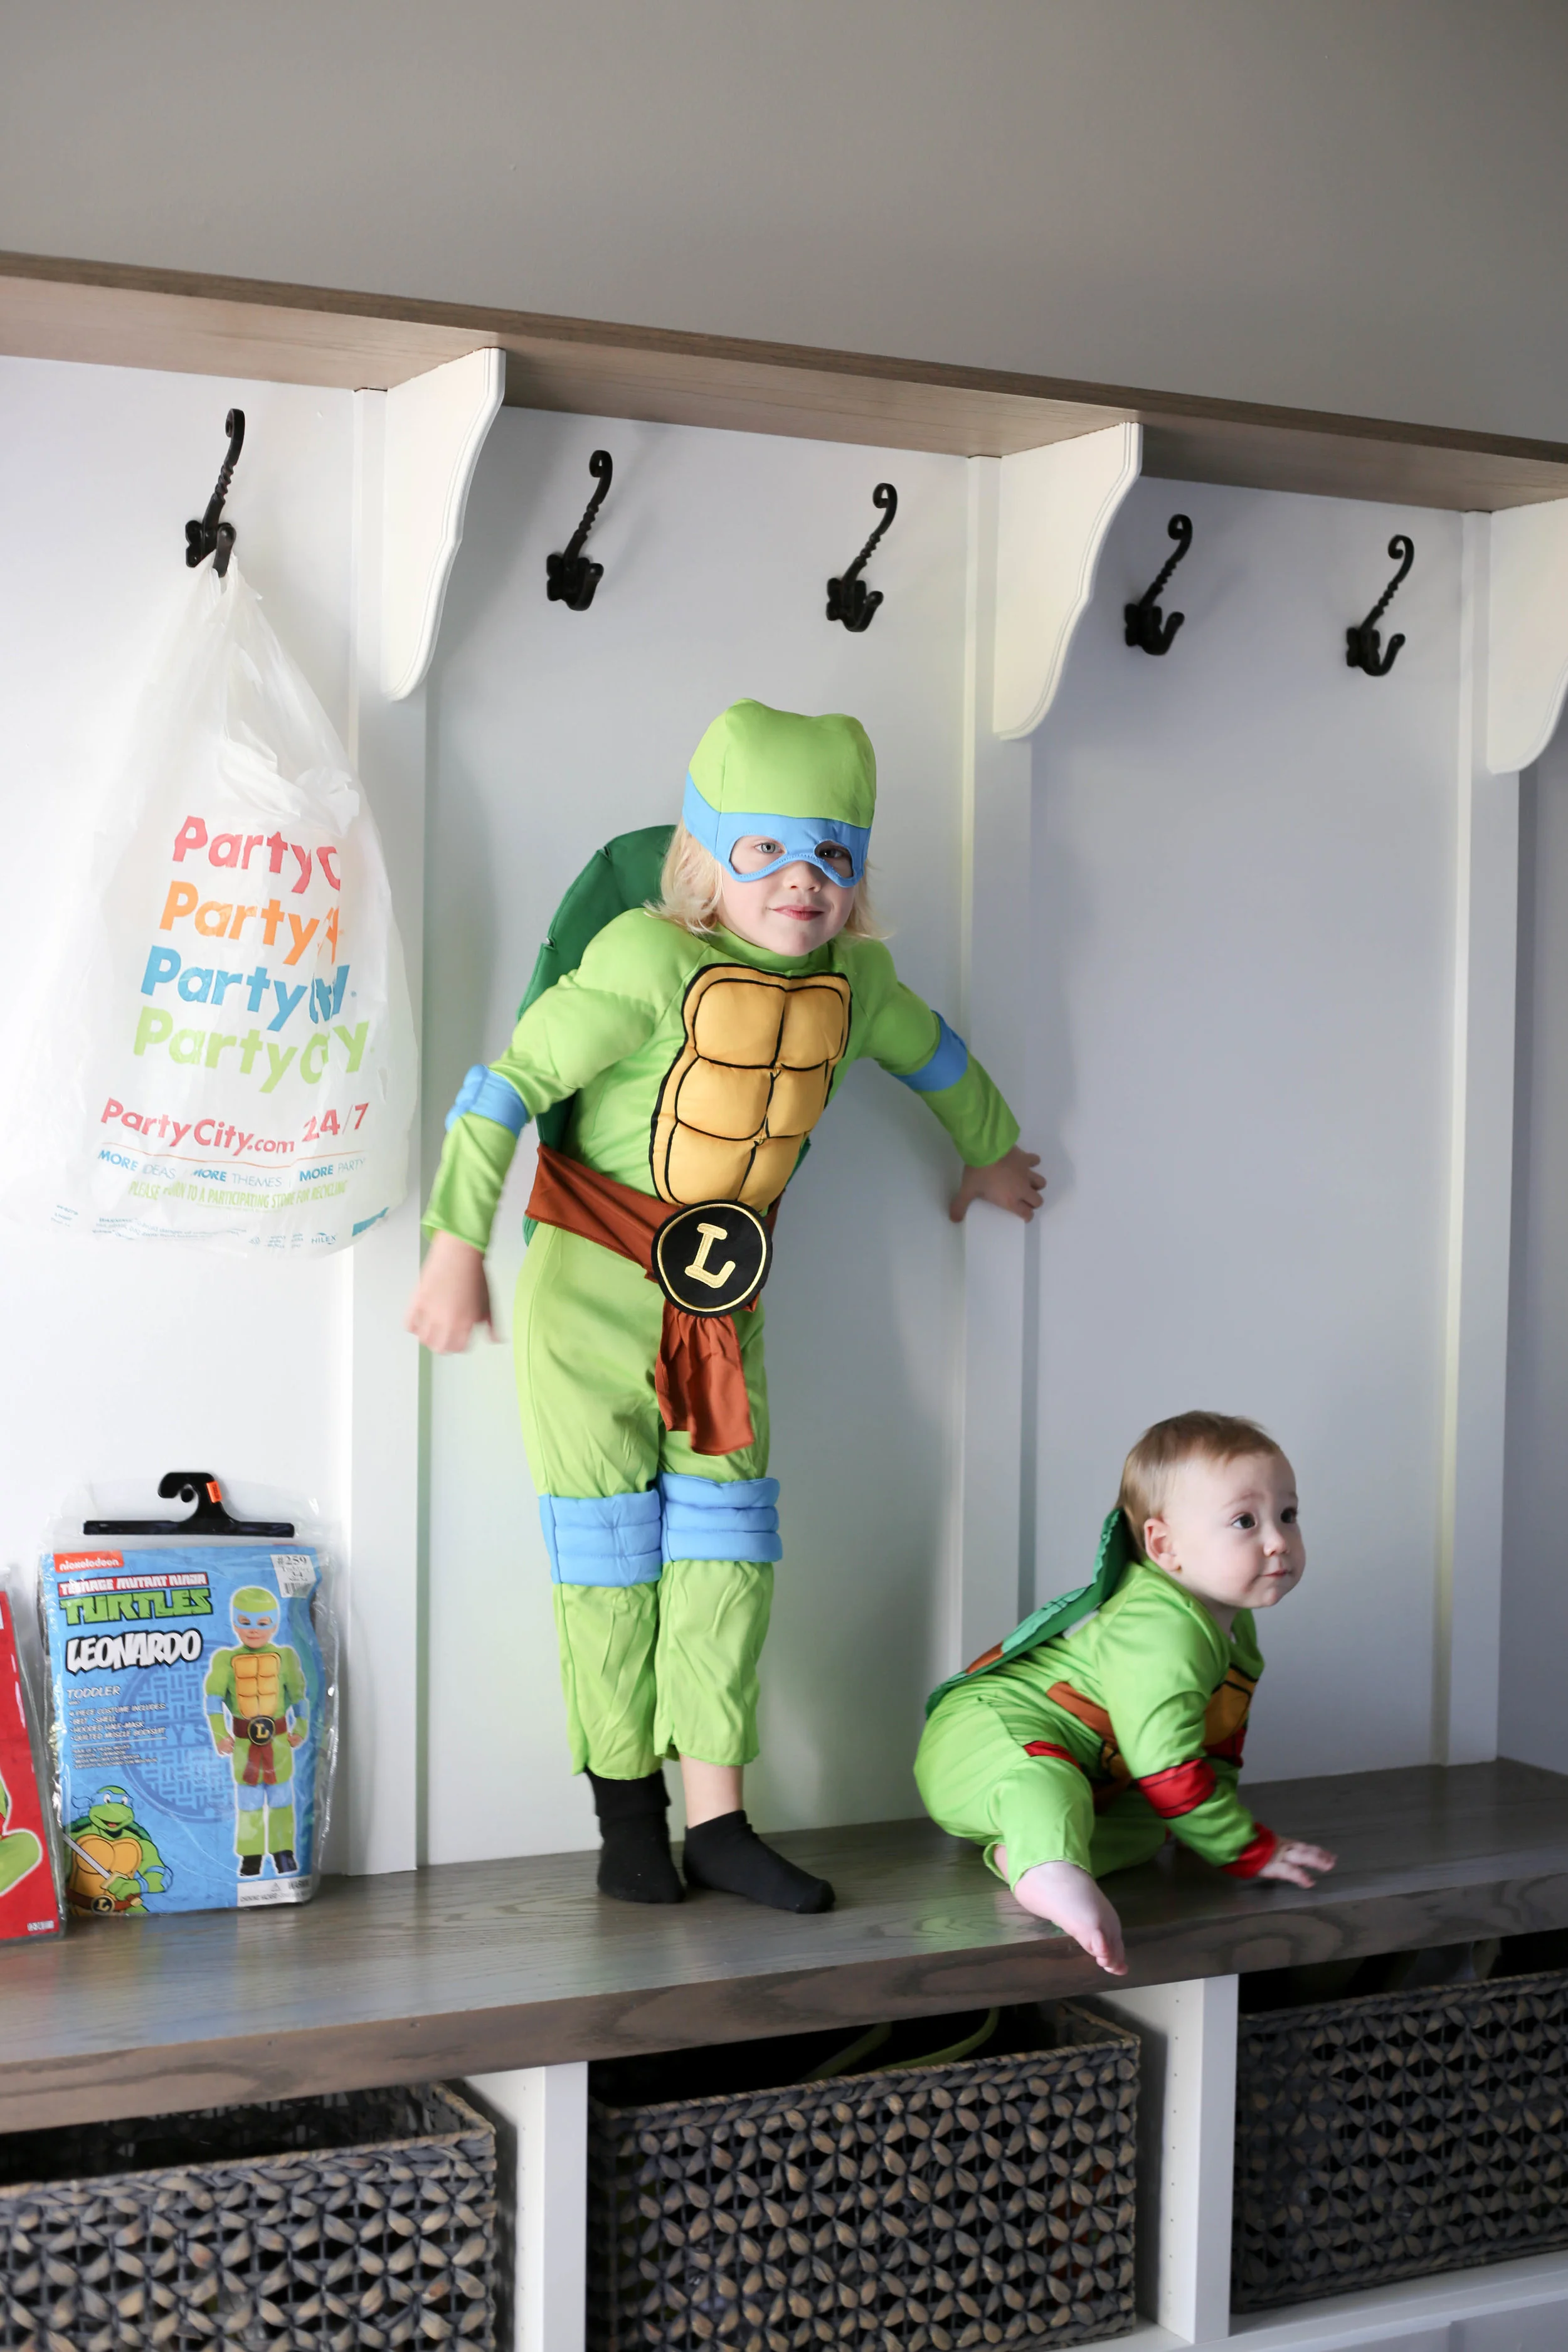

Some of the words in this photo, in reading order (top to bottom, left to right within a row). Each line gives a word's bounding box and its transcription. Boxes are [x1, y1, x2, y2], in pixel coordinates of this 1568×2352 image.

[301, 1101, 371, 1143] 24/7
[97, 1149, 139, 1172] MORE
[231, 1172, 282, 1188] THEMES
[299, 1164, 334, 1182] MORE
[337, 1158, 366, 1175] PARTY
[128, 1180, 161, 1201] PLEASE
[187, 1183, 198, 1202] TO
[198, 1185, 206, 1203] A
[207, 1187, 270, 1209] PARTICIPATING
[684, 1222, 736, 1289] L
[60, 1558, 119, 1572] nickelodeon
[116, 1575, 168, 1591] MUTANT
[168, 1572, 207, 1587] NINJA
[59, 1587, 214, 1626] TURTLES
[65, 1628, 204, 1677] LEONARDO
[66, 1685, 121, 1700] TODDLER
[255, 1723, 270, 1739] L
[97, 1899, 110, 1912] L
